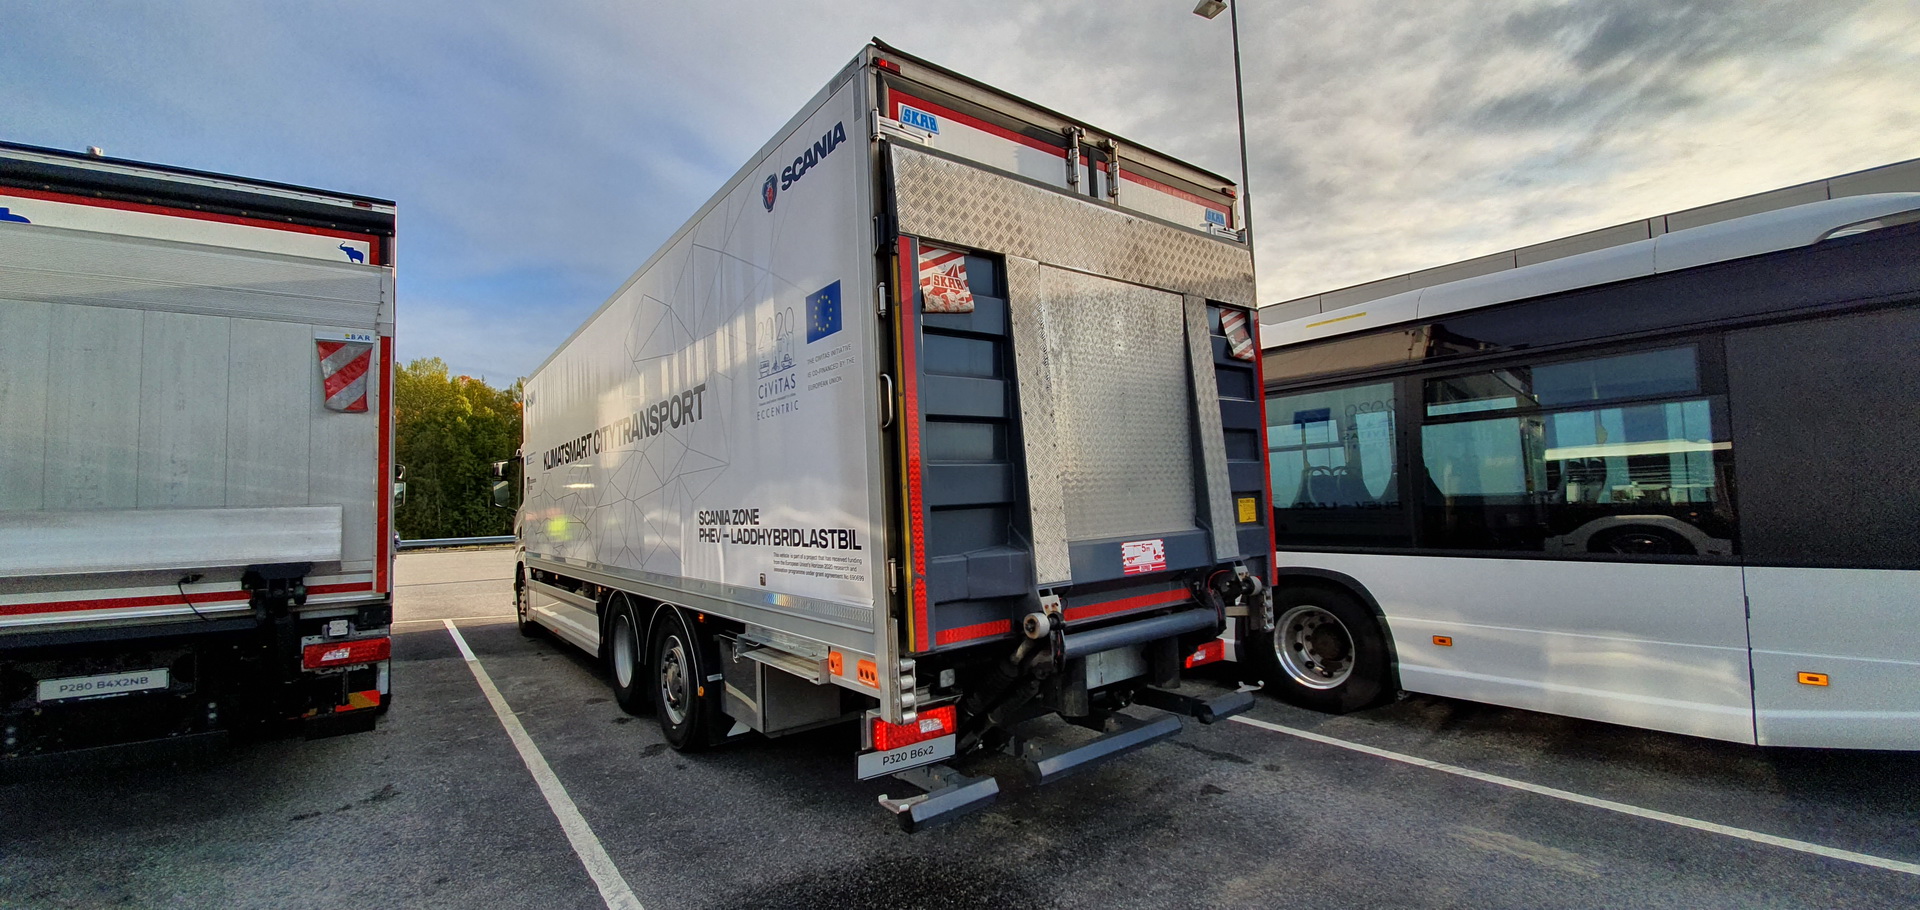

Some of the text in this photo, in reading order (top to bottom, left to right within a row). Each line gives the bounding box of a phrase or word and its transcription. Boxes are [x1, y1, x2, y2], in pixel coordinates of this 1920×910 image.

[903, 109, 938, 132] SKAB
[781, 121, 847, 191] SCANIA
[933, 274, 965, 291] SKAB
[831, 344, 852, 356] INITIATIVE
[847, 356, 855, 364] THE
[807, 380, 829, 391] EUROPEAN
[757, 399, 799, 421] ECCENTRIC
[543, 433, 593, 471] KLIMATSMART
[699, 508, 760, 526] SCANIA ZONE
[698, 528, 722, 543] PHEV
[730, 528, 863, 550] LADDHYBRIDLASTBIL
[60, 676, 149, 693] P280 B4X2NB
[882, 745, 934, 766] P320 B6x2
